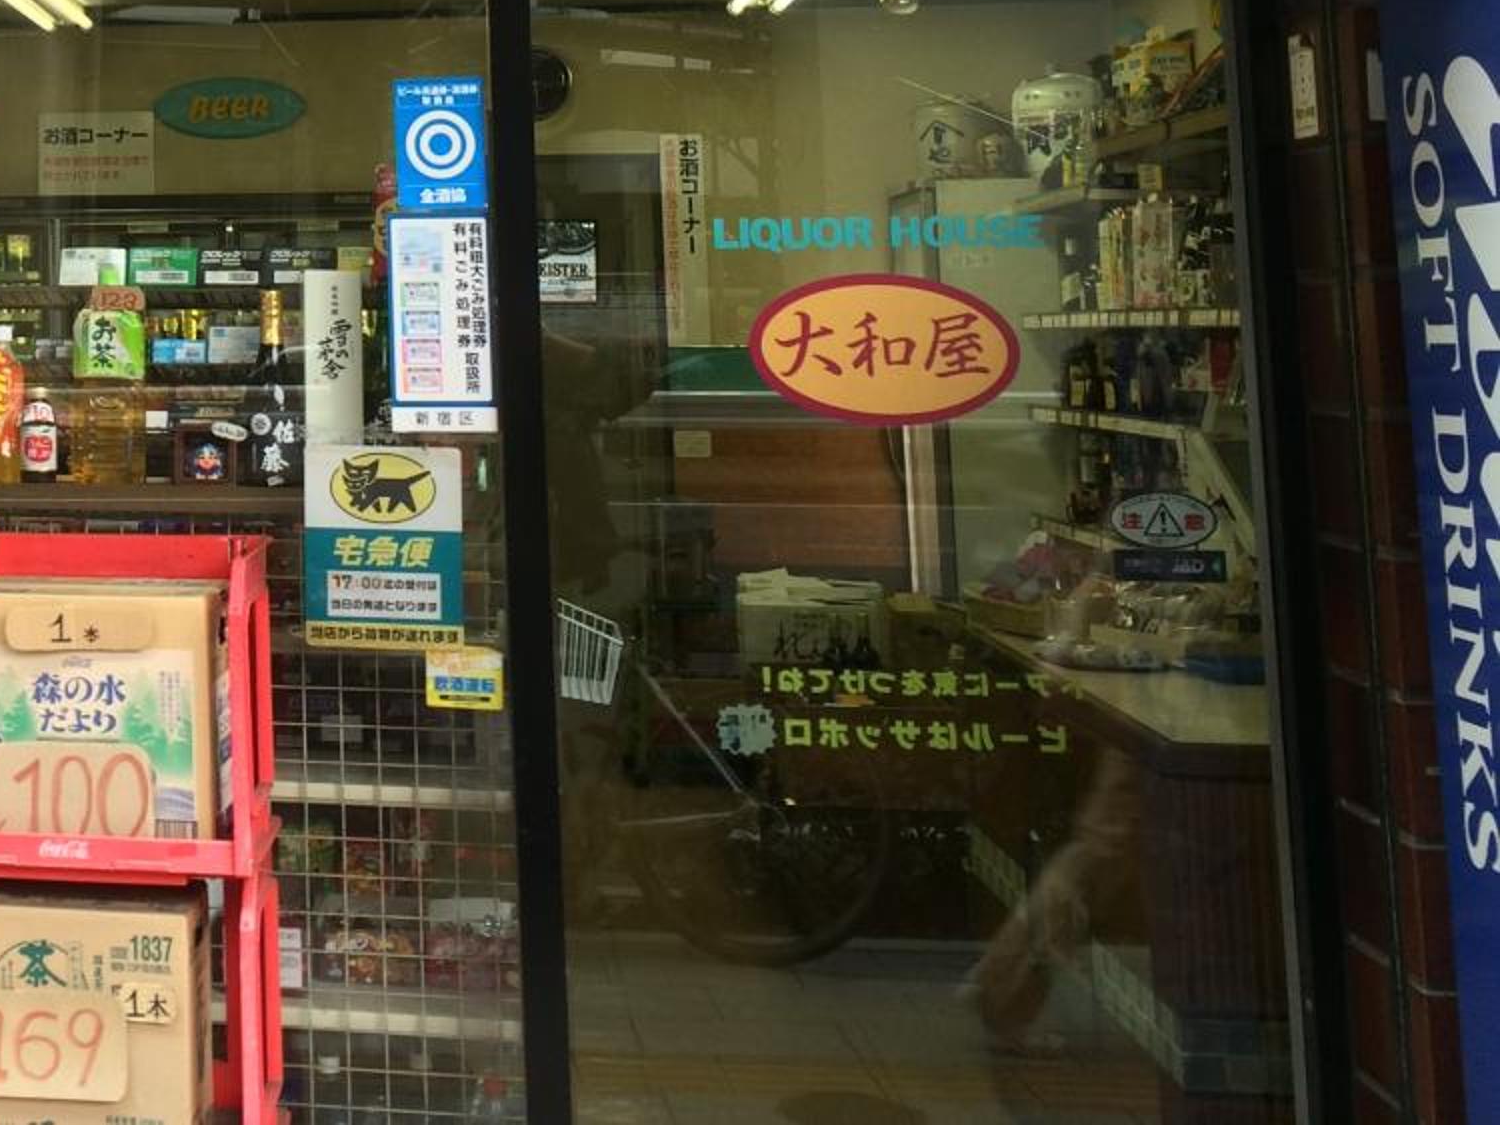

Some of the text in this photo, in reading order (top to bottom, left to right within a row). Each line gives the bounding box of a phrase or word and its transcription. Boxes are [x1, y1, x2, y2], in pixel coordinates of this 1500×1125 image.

[43, 126, 149, 146] お酒コーナー
[679, 139, 701, 254] お酒コーナー
[712, 212, 1044, 253] LIQUOR HOUSE
[1402, 71, 1463, 373] SOFT
[91, 316, 117, 369] お茶
[772, 309, 992, 379] 大和屋
[415, 410, 475, 426] 新宿区
[260, 418, 296, 473] 佐藤
[333, 535, 434, 568] 宅急便
[1431, 406, 1499, 874] DRINKS
[32, 672, 127, 706] 森の水
[38, 706, 118, 734] だより
[18, 938, 67, 987] 茶
[130, 935, 173, 963] 1837
[125, 989, 171, 1018] 1本
